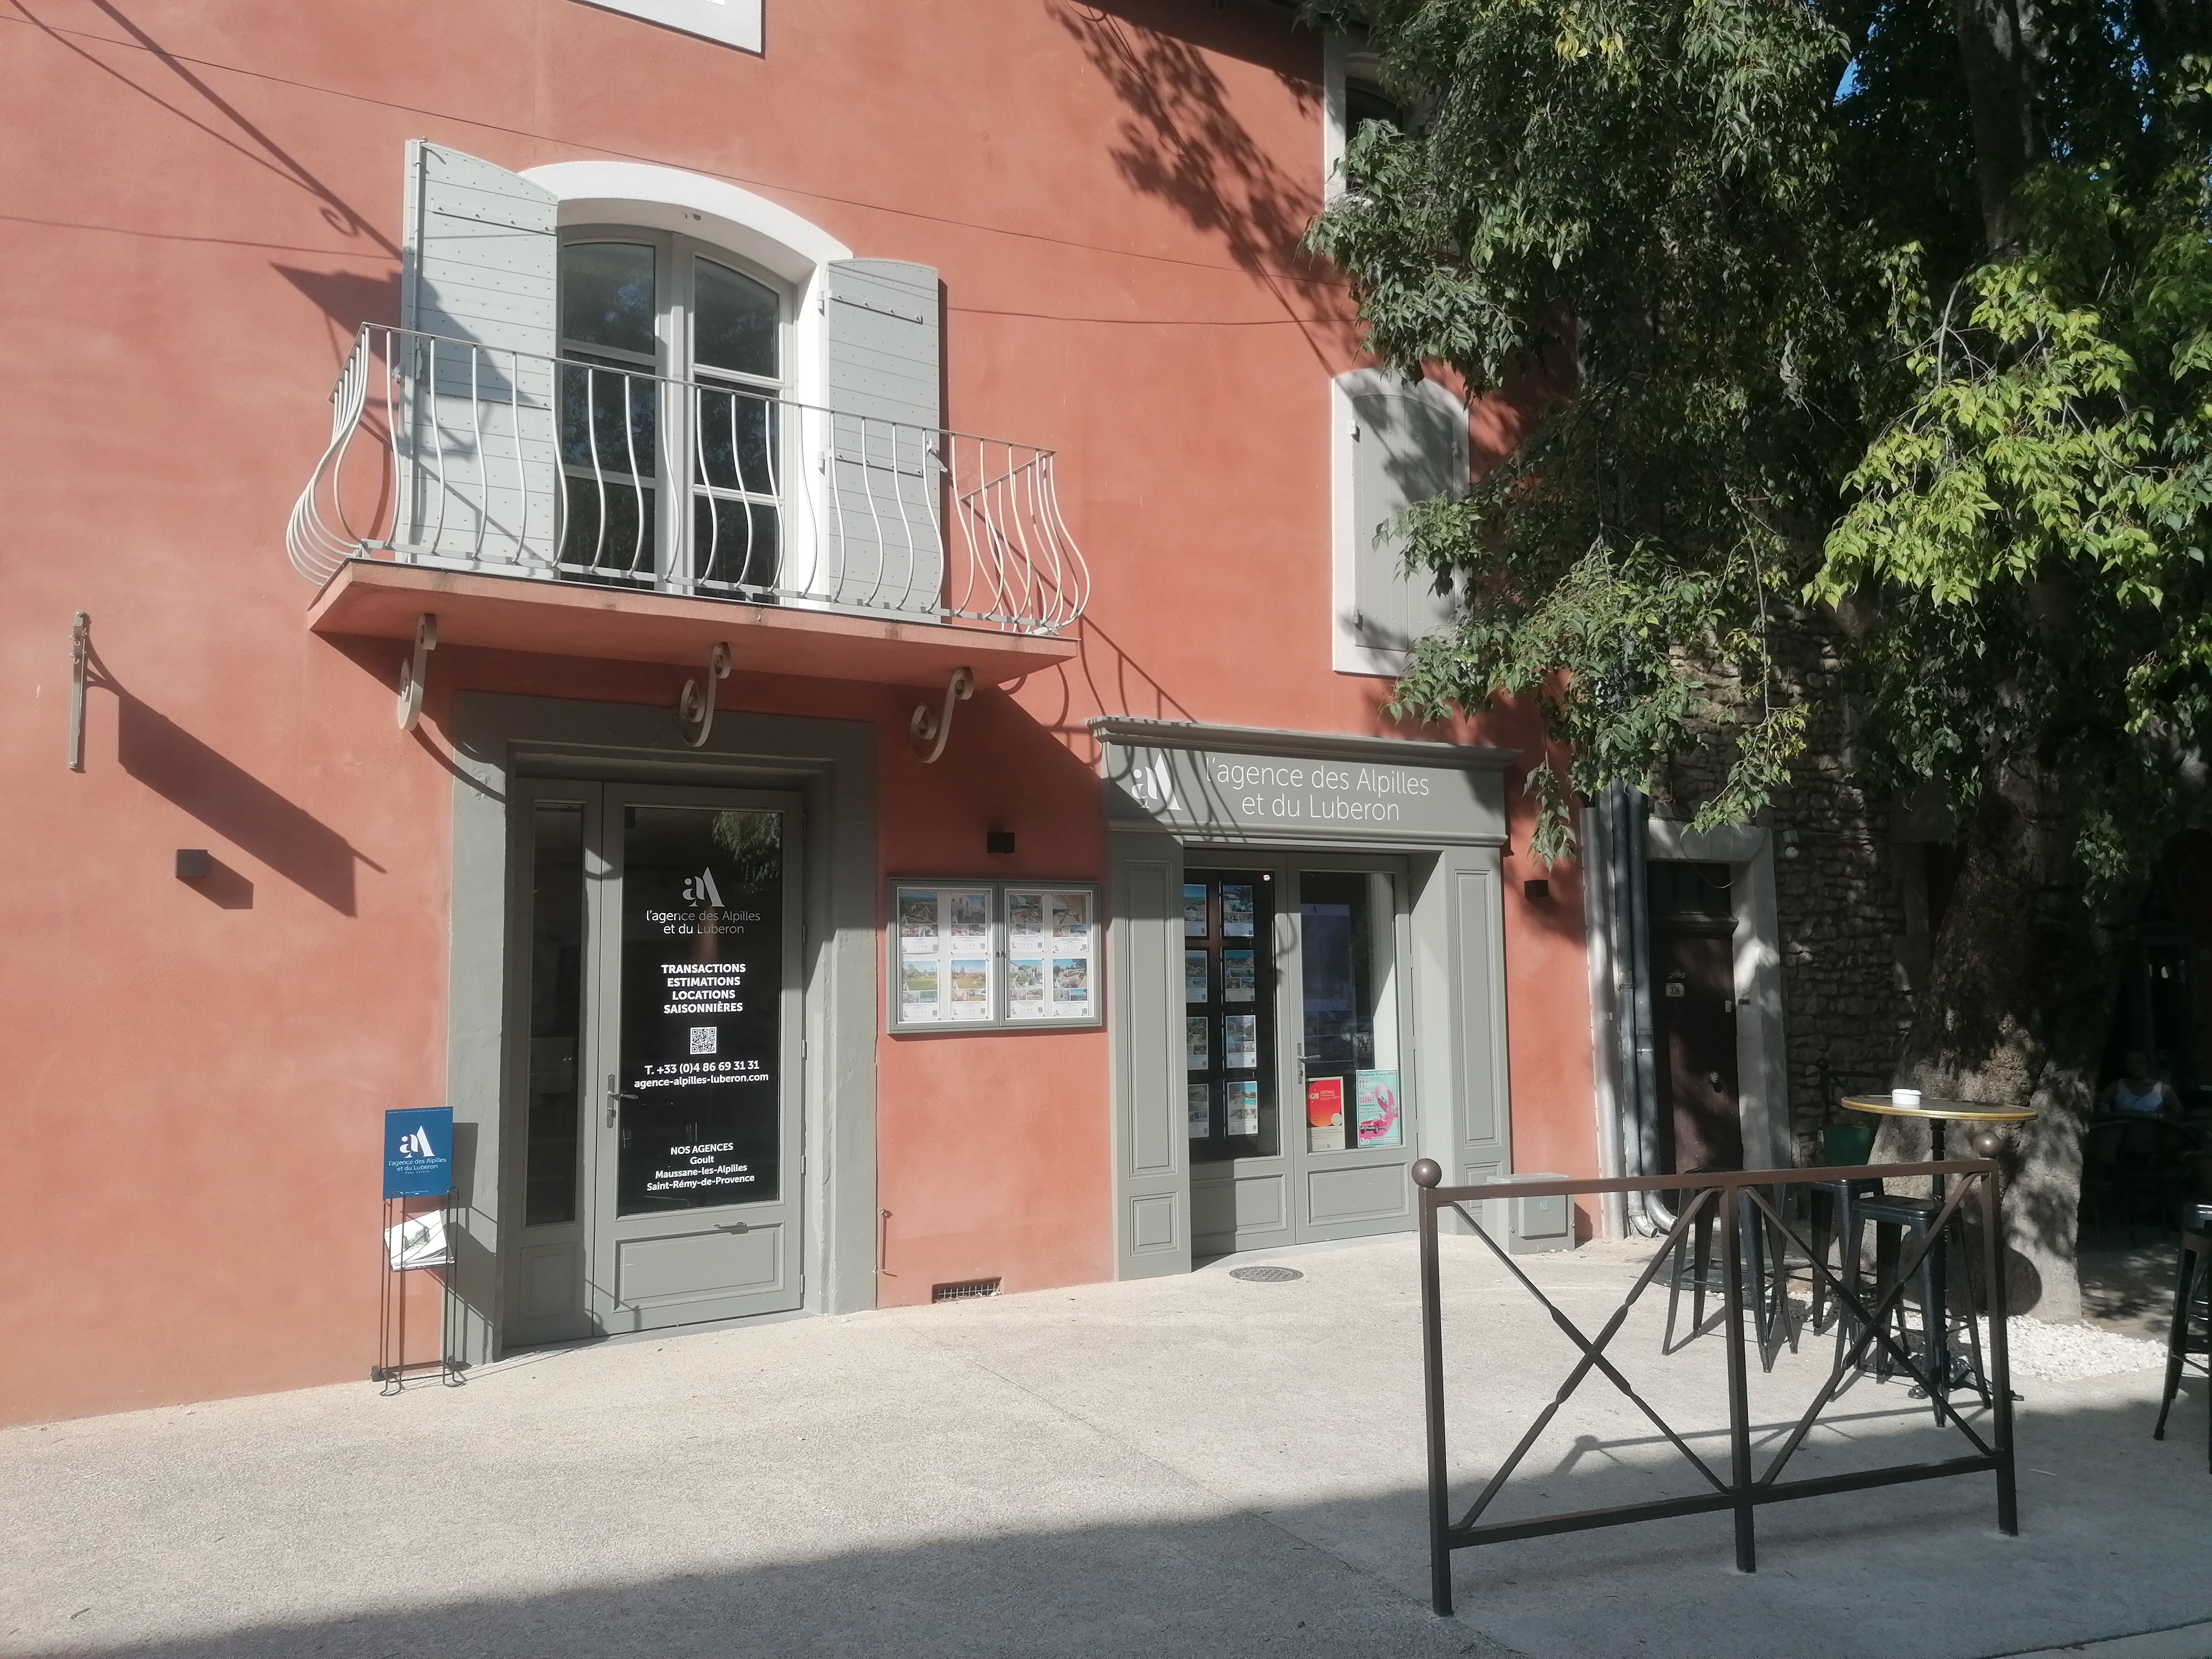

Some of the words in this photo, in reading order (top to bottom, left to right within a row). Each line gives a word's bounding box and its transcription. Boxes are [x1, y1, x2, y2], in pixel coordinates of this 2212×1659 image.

[1206, 757, 1303, 791] l'agence
[1312, 765, 1349, 790] des
[1357, 768, 1429, 797] Alpilles
[1242, 793, 1264, 815] et
[1272, 793, 1300, 817] du
[1310, 795, 1400, 821] Luberon
[646, 910, 695, 923] l'agence
[699, 911, 718, 921] des
[722, 911, 760, 923] Alpilles
[664, 924, 675, 934] et
[679, 924, 693, 934] du
[697, 924, 744, 934] Luberon
[661, 963, 746, 974] TRANSACTIONS
[667, 977, 740, 987] ESTIMATIONS
[672, 990, 735, 1000] LOCATIONS
[663, 1001, 743, 1014] SAISONNIÈRES
[644, 1065, 654, 1075] T.
[657, 1063, 677, 1074] +33
[679, 1063, 700, 1074] (0)4
[702, 1062, 716, 1072] 86
[718, 1062, 731, 1071] 69
[733, 1061, 746, 1070] 31
[748, 1060, 759, 1070] 31
[634, 1073, 769, 1090] agence-alpilles-luberon.com
[671, 1145, 690, 1155] NOS
[692, 1142, 734, 1154] AGENCES
[690, 1156, 714, 1165] Goult
[655, 1165, 747, 1179] Maussane-les-Alpilles
[646, 1175, 755, 1191] Saint-Rémy-de-Provence
